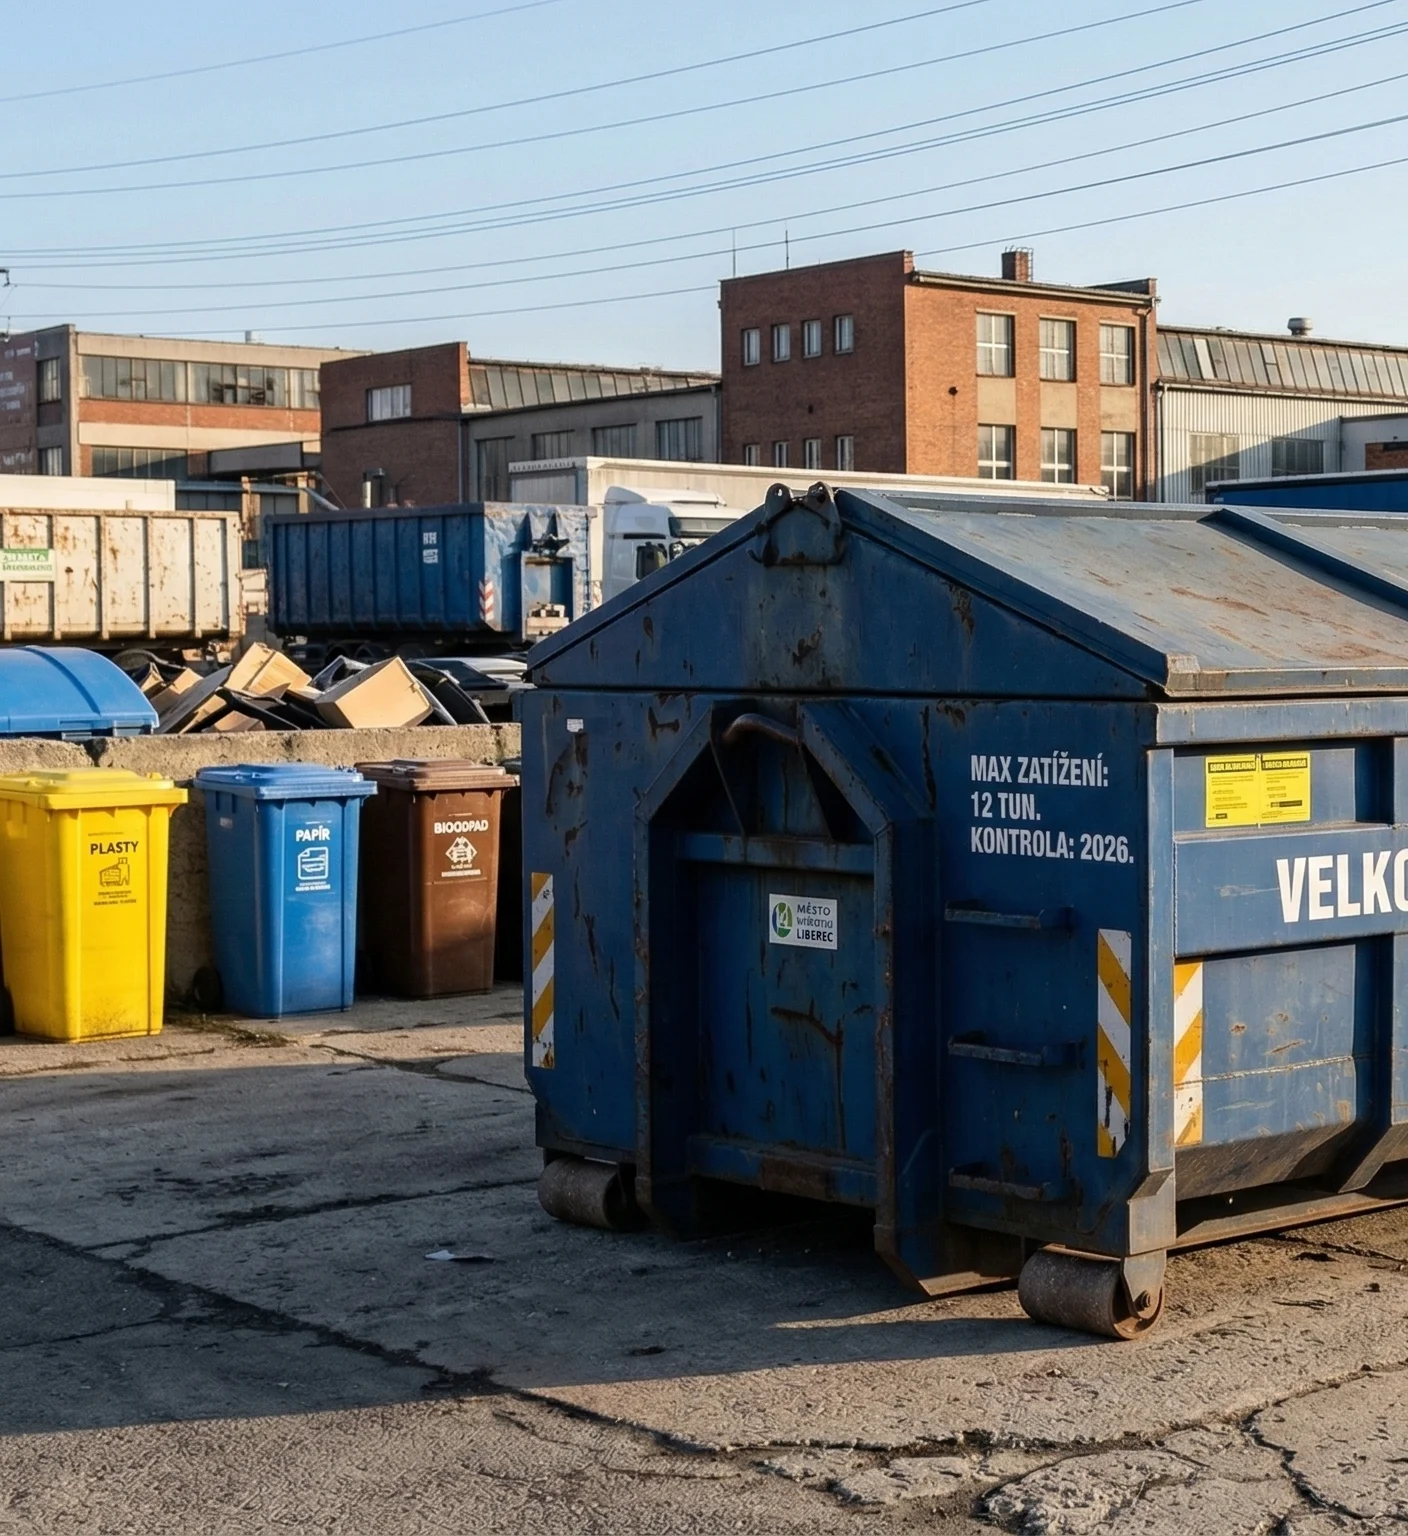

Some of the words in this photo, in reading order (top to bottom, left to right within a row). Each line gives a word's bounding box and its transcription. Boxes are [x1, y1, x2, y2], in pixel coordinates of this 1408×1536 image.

[970, 754, 1012, 783] MAX
[1017, 750, 1109, 788] ZATÍŽENÍ:
[970, 791, 993, 819] 12
[997, 792, 1041, 821] TUN.
[295, 824, 331, 842] PAPÍR
[433, 819, 489, 835] BIOODPAD
[90, 840, 139, 855] PLASTY
[970, 826, 1074, 859] KONTROLA:
[1080, 833, 1134, 864] 2026.
[796, 928, 834, 943] LIBEREC
